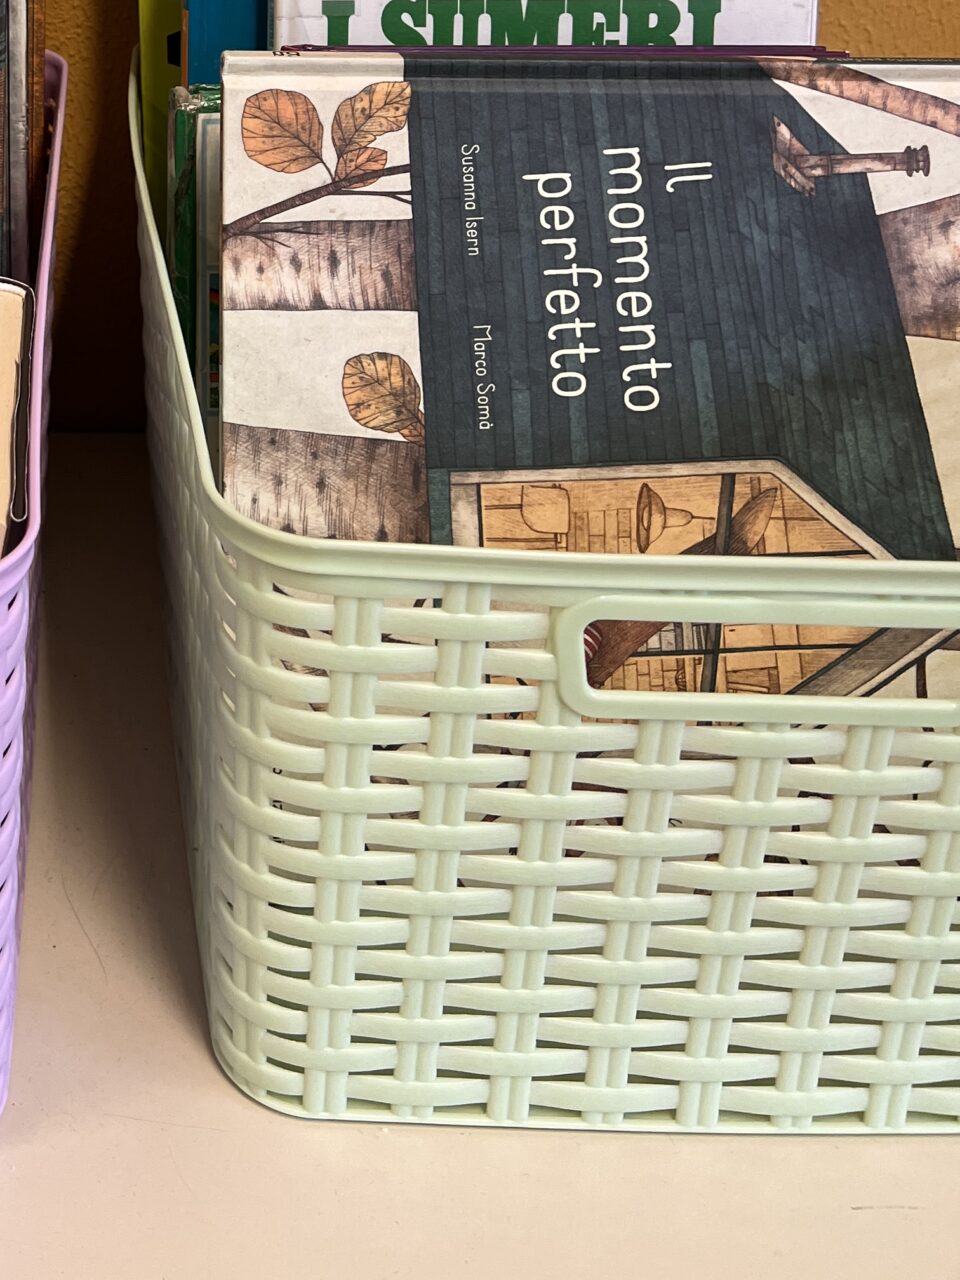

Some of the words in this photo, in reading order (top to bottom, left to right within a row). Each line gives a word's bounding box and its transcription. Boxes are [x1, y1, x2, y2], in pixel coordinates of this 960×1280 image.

[321, 0, 356, 46] I
[460, 143, 481, 212] Susanna
[663, 160, 714, 194] Il
[465, 215, 486, 257] Isern
[521, 171, 604, 398] perfetto
[602, 145, 674, 412] momento
[472, 324, 493, 377] Marco
